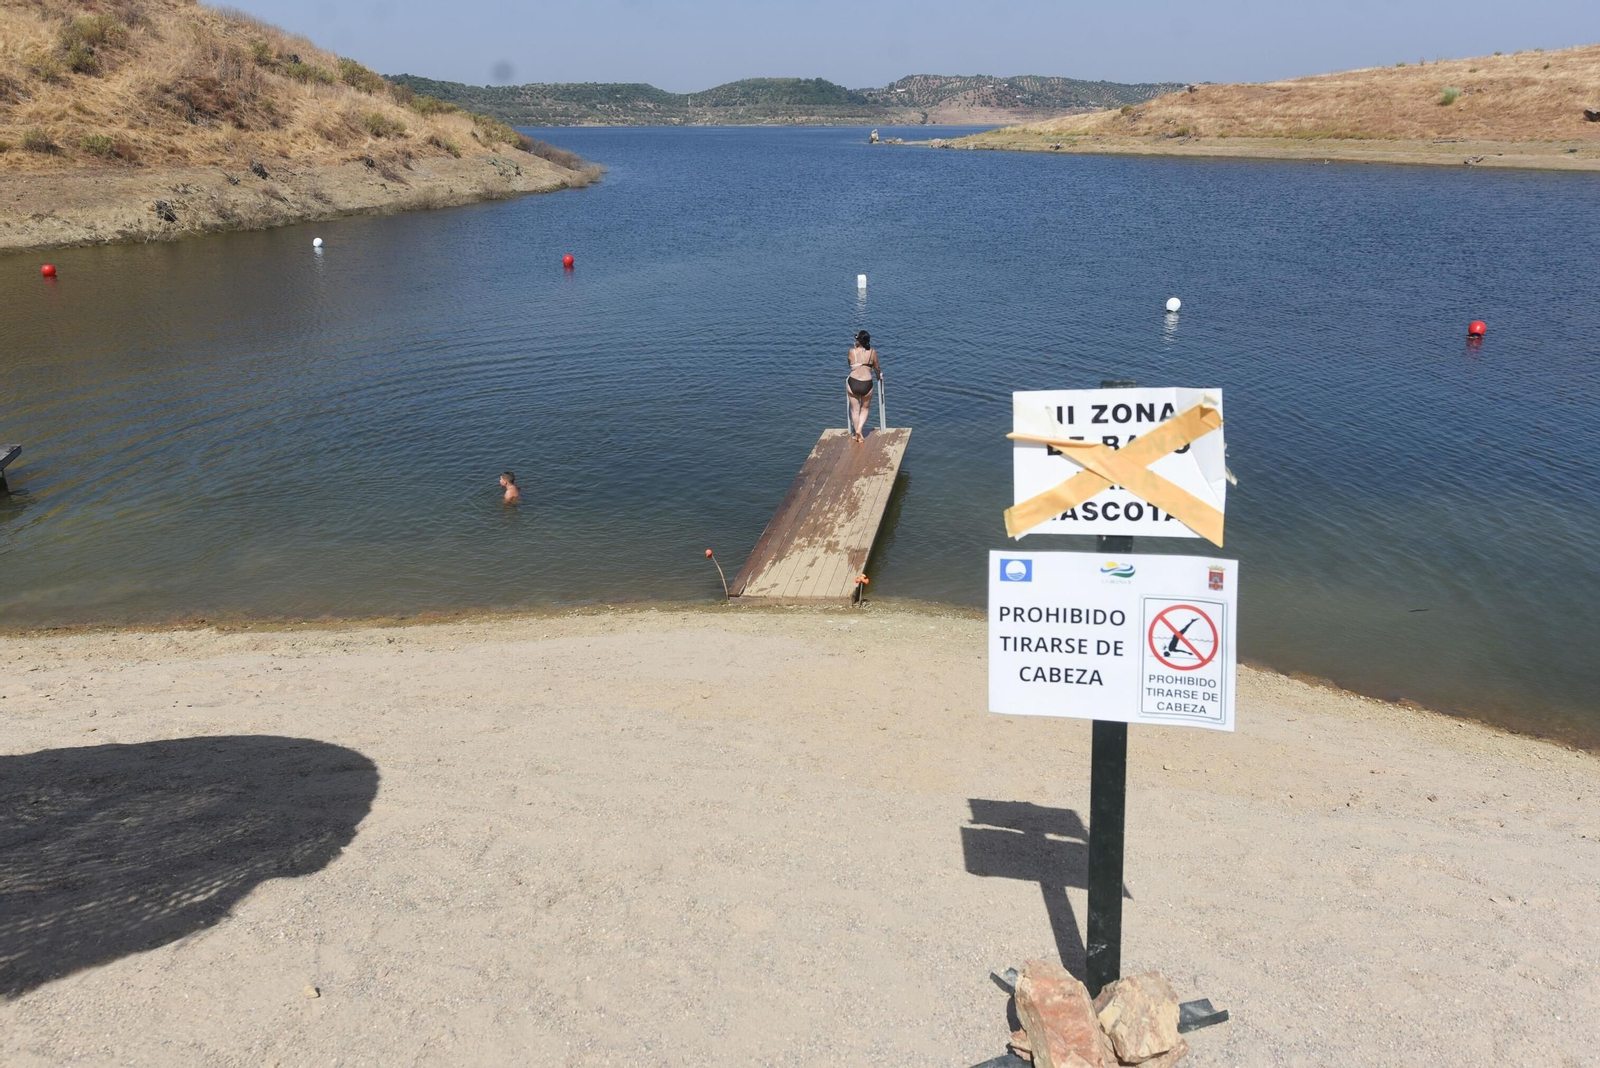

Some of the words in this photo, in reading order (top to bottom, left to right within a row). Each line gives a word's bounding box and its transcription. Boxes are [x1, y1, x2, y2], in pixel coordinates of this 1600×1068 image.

[1091, 402, 1178, 424] ZONA
[999, 606, 1126, 626] PROHIBIDO
[999, 636, 1088, 655] TIRARSE
[1096, 640, 1124, 657] DE
[1019, 666, 1104, 687] CABEZA
[1148, 674, 1217, 689] PROHIBIDO
[1146, 687, 1198, 700] TIRARSE
[1202, 691, 1219, 702] DE
[1156, 701, 1207, 715] CABEZA
